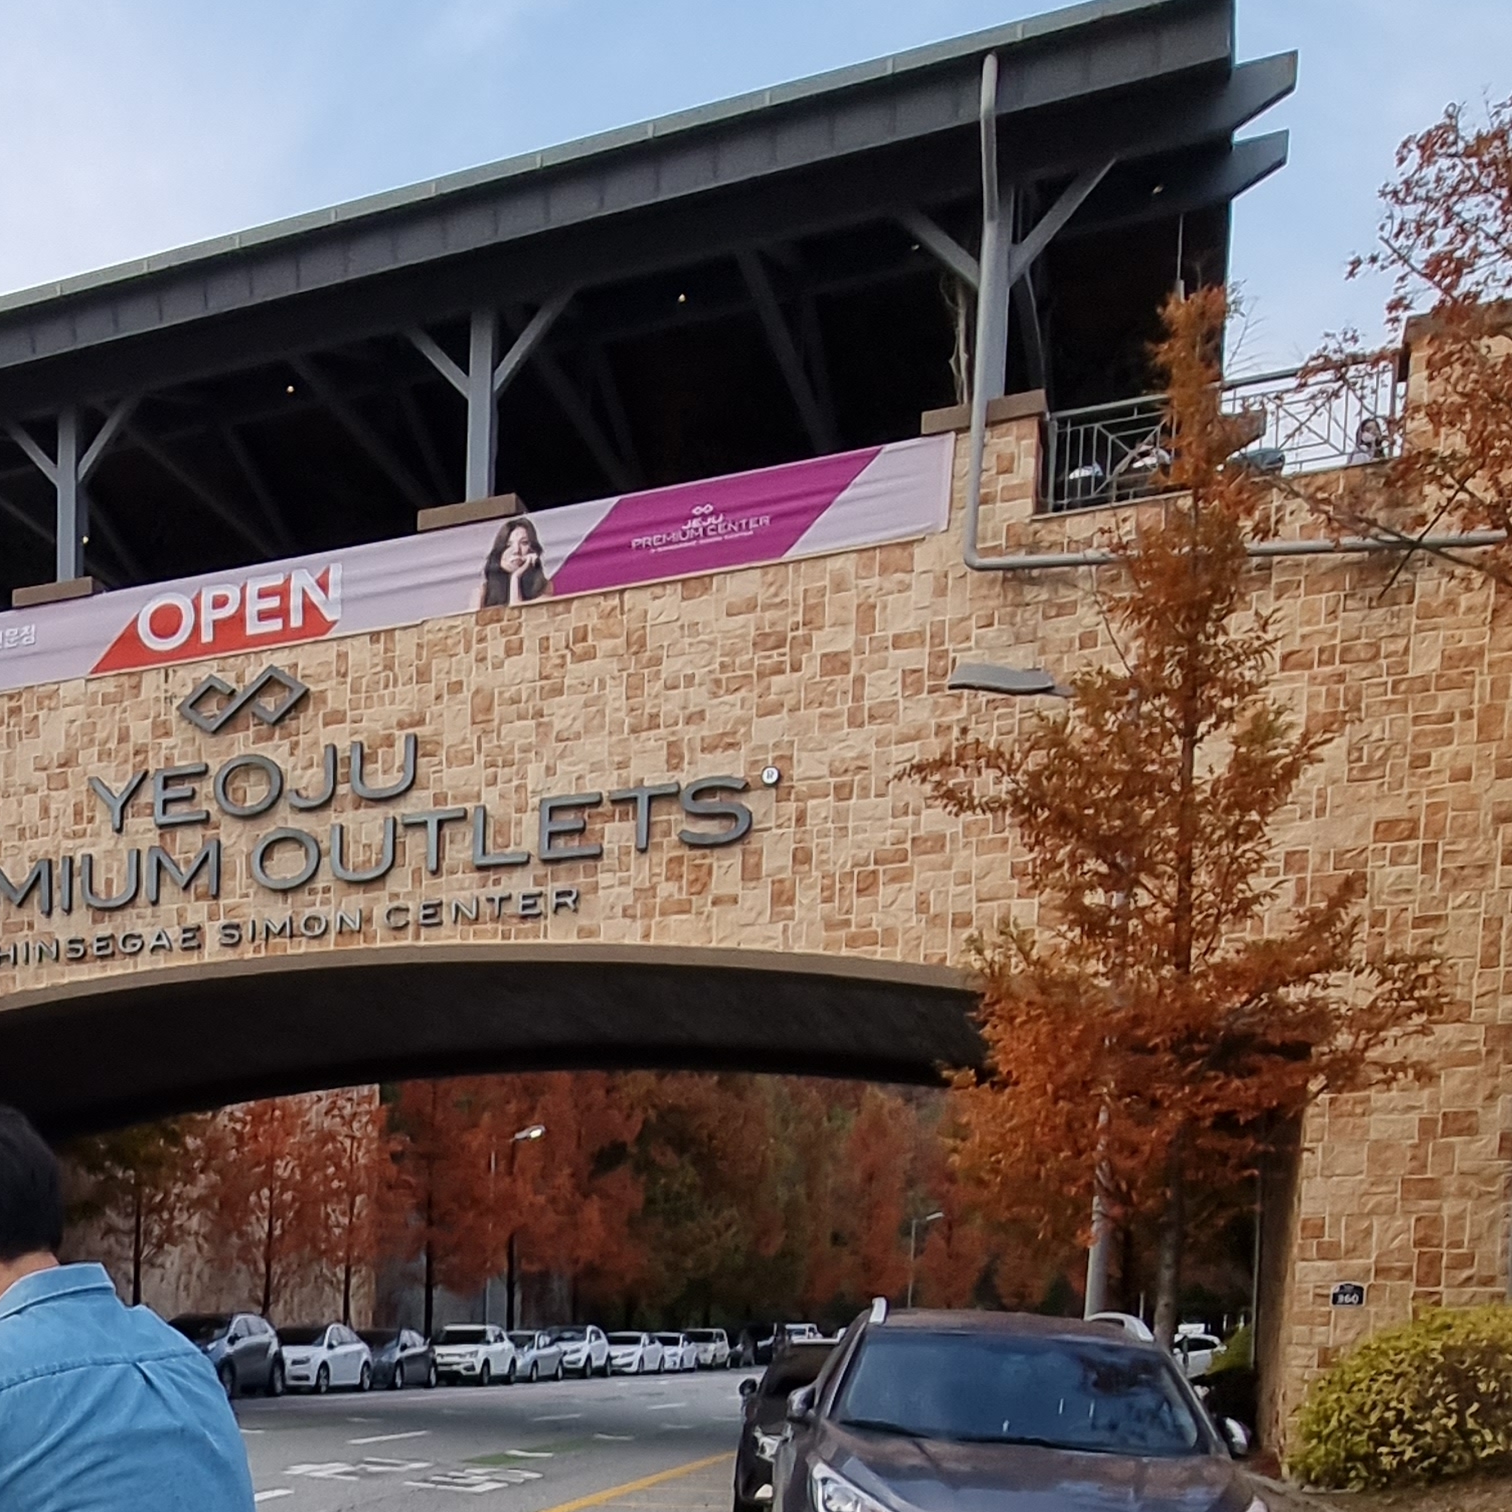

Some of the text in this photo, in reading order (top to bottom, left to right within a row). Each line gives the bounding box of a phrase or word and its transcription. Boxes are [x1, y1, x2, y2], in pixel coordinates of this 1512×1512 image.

[631, 526, 704, 549] PREMIUM
[706, 515, 771, 537] CENTER
[681, 513, 725, 530] JEJU
[137, 562, 343, 652] OPEN
[90, 732, 418, 833] YEOJU
[251, 774, 753, 891] OUTLETS
[217, 906, 363, 947] SIMON
[385, 888, 580, 931] CENTER
